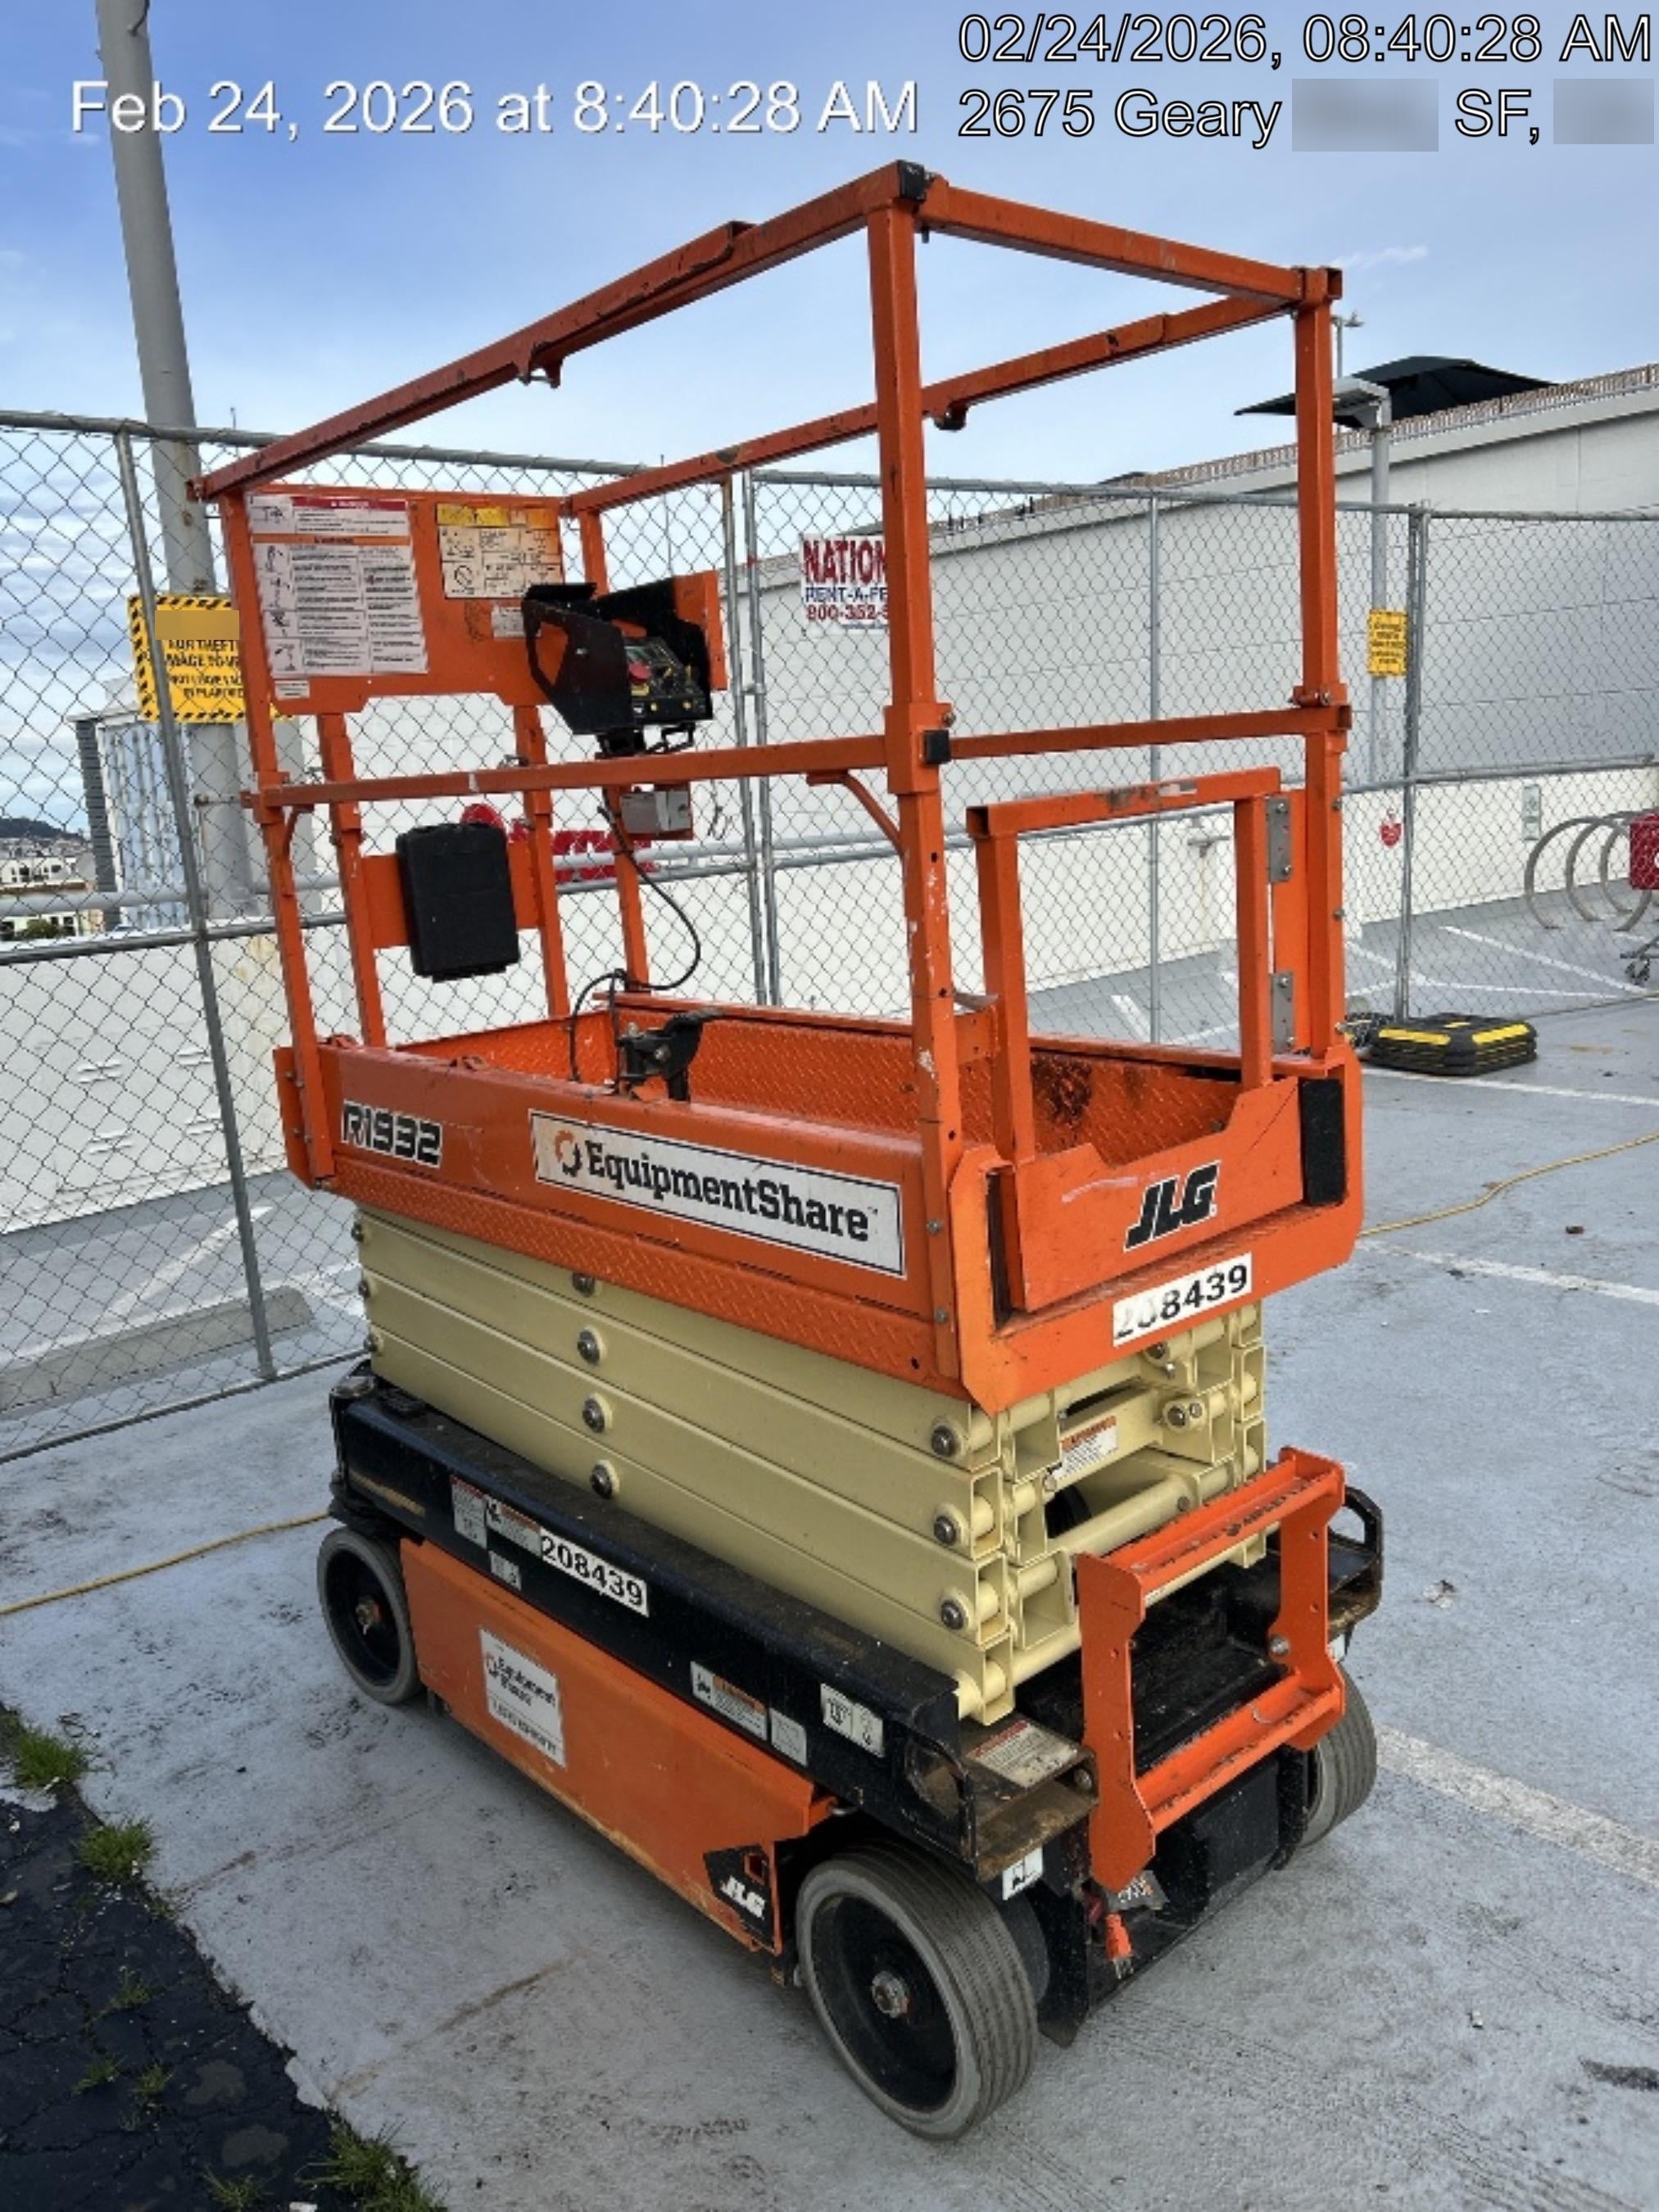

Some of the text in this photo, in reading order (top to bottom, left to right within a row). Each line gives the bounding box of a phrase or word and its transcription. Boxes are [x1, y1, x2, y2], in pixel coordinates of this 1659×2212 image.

[341, 1099, 442, 1168] R1932
[584, 1139, 870, 1242] EquipmentShare
[1122, 1159, 1221, 1254] JLG
[541, 1534, 644, 1607] 208439
